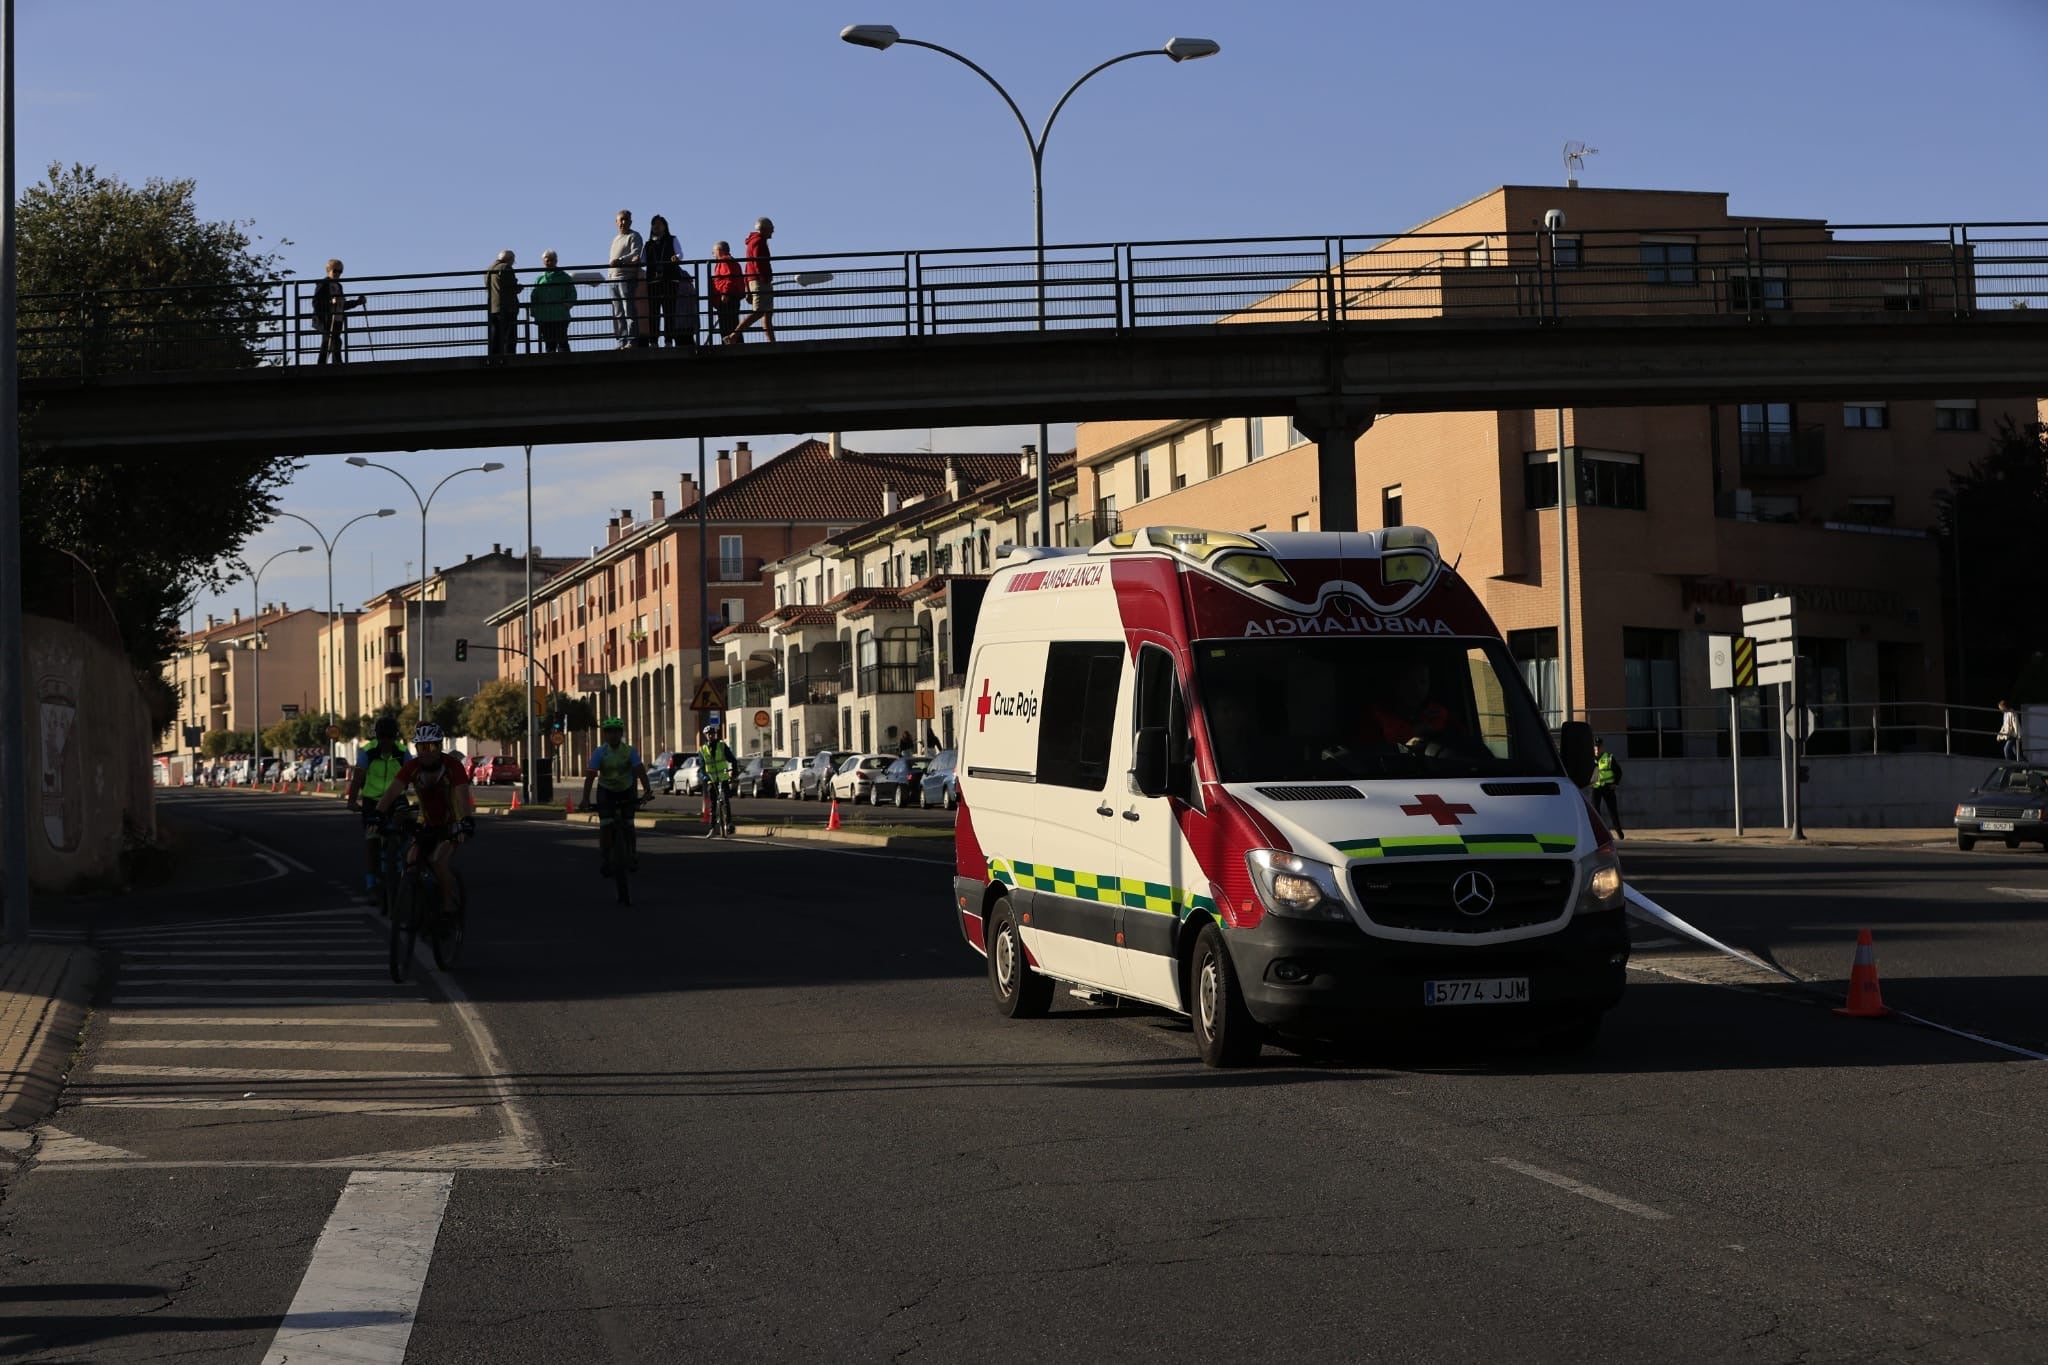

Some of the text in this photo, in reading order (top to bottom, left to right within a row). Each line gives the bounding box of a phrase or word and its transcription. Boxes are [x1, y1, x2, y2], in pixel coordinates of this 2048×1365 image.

[1040, 564, 1105, 590] AMBULANCIA
[994, 689, 1038, 724] Cruz Roja
[1436, 981, 1526, 1002] 5774 JJM
